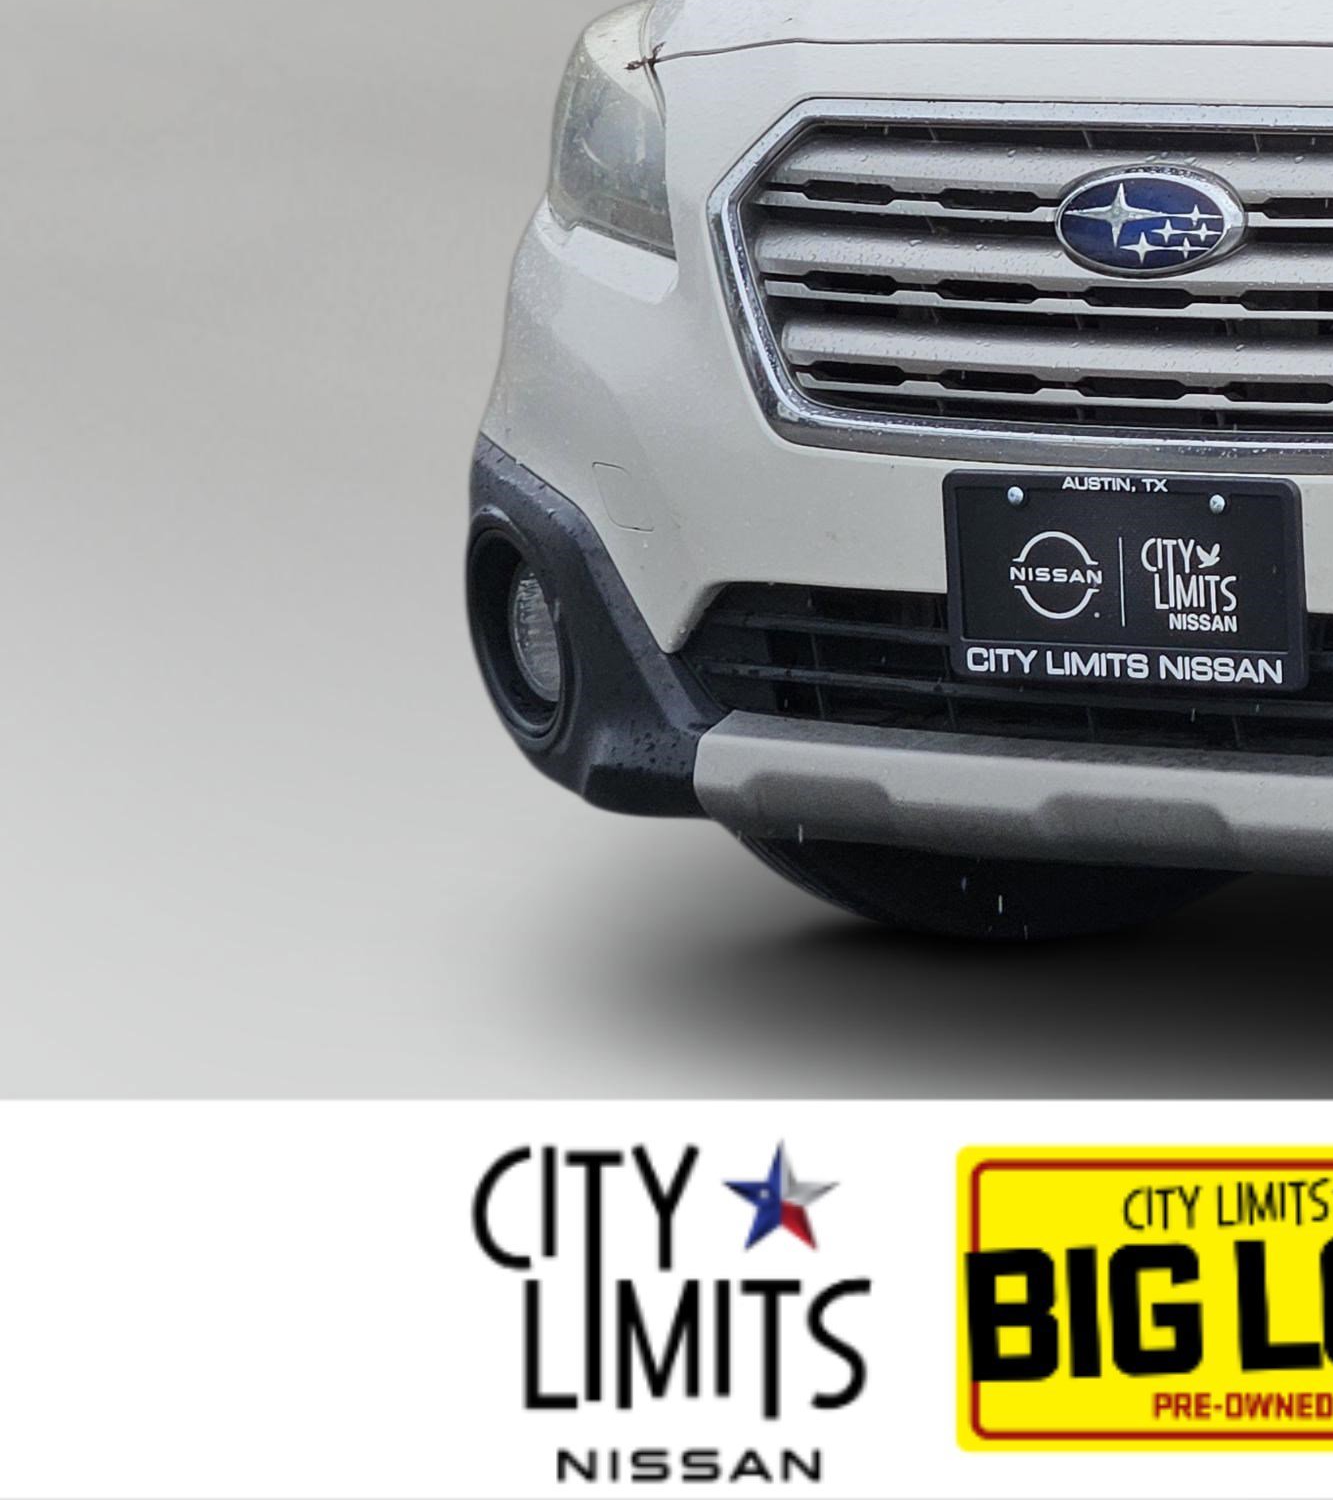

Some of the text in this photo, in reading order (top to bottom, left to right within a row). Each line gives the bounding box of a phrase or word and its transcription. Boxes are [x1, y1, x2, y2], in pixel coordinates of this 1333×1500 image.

[1062, 476, 1168, 493] AUSTIN, TX
[1141, 537, 1196, 574] CITY
[1010, 566, 1102, 585] NISSAN
[1154, 574, 1238, 614] LIMITS
[1169, 614, 1238, 633] NISSAN
[966, 647, 1283, 684] CITY LIMITS NISSAN
